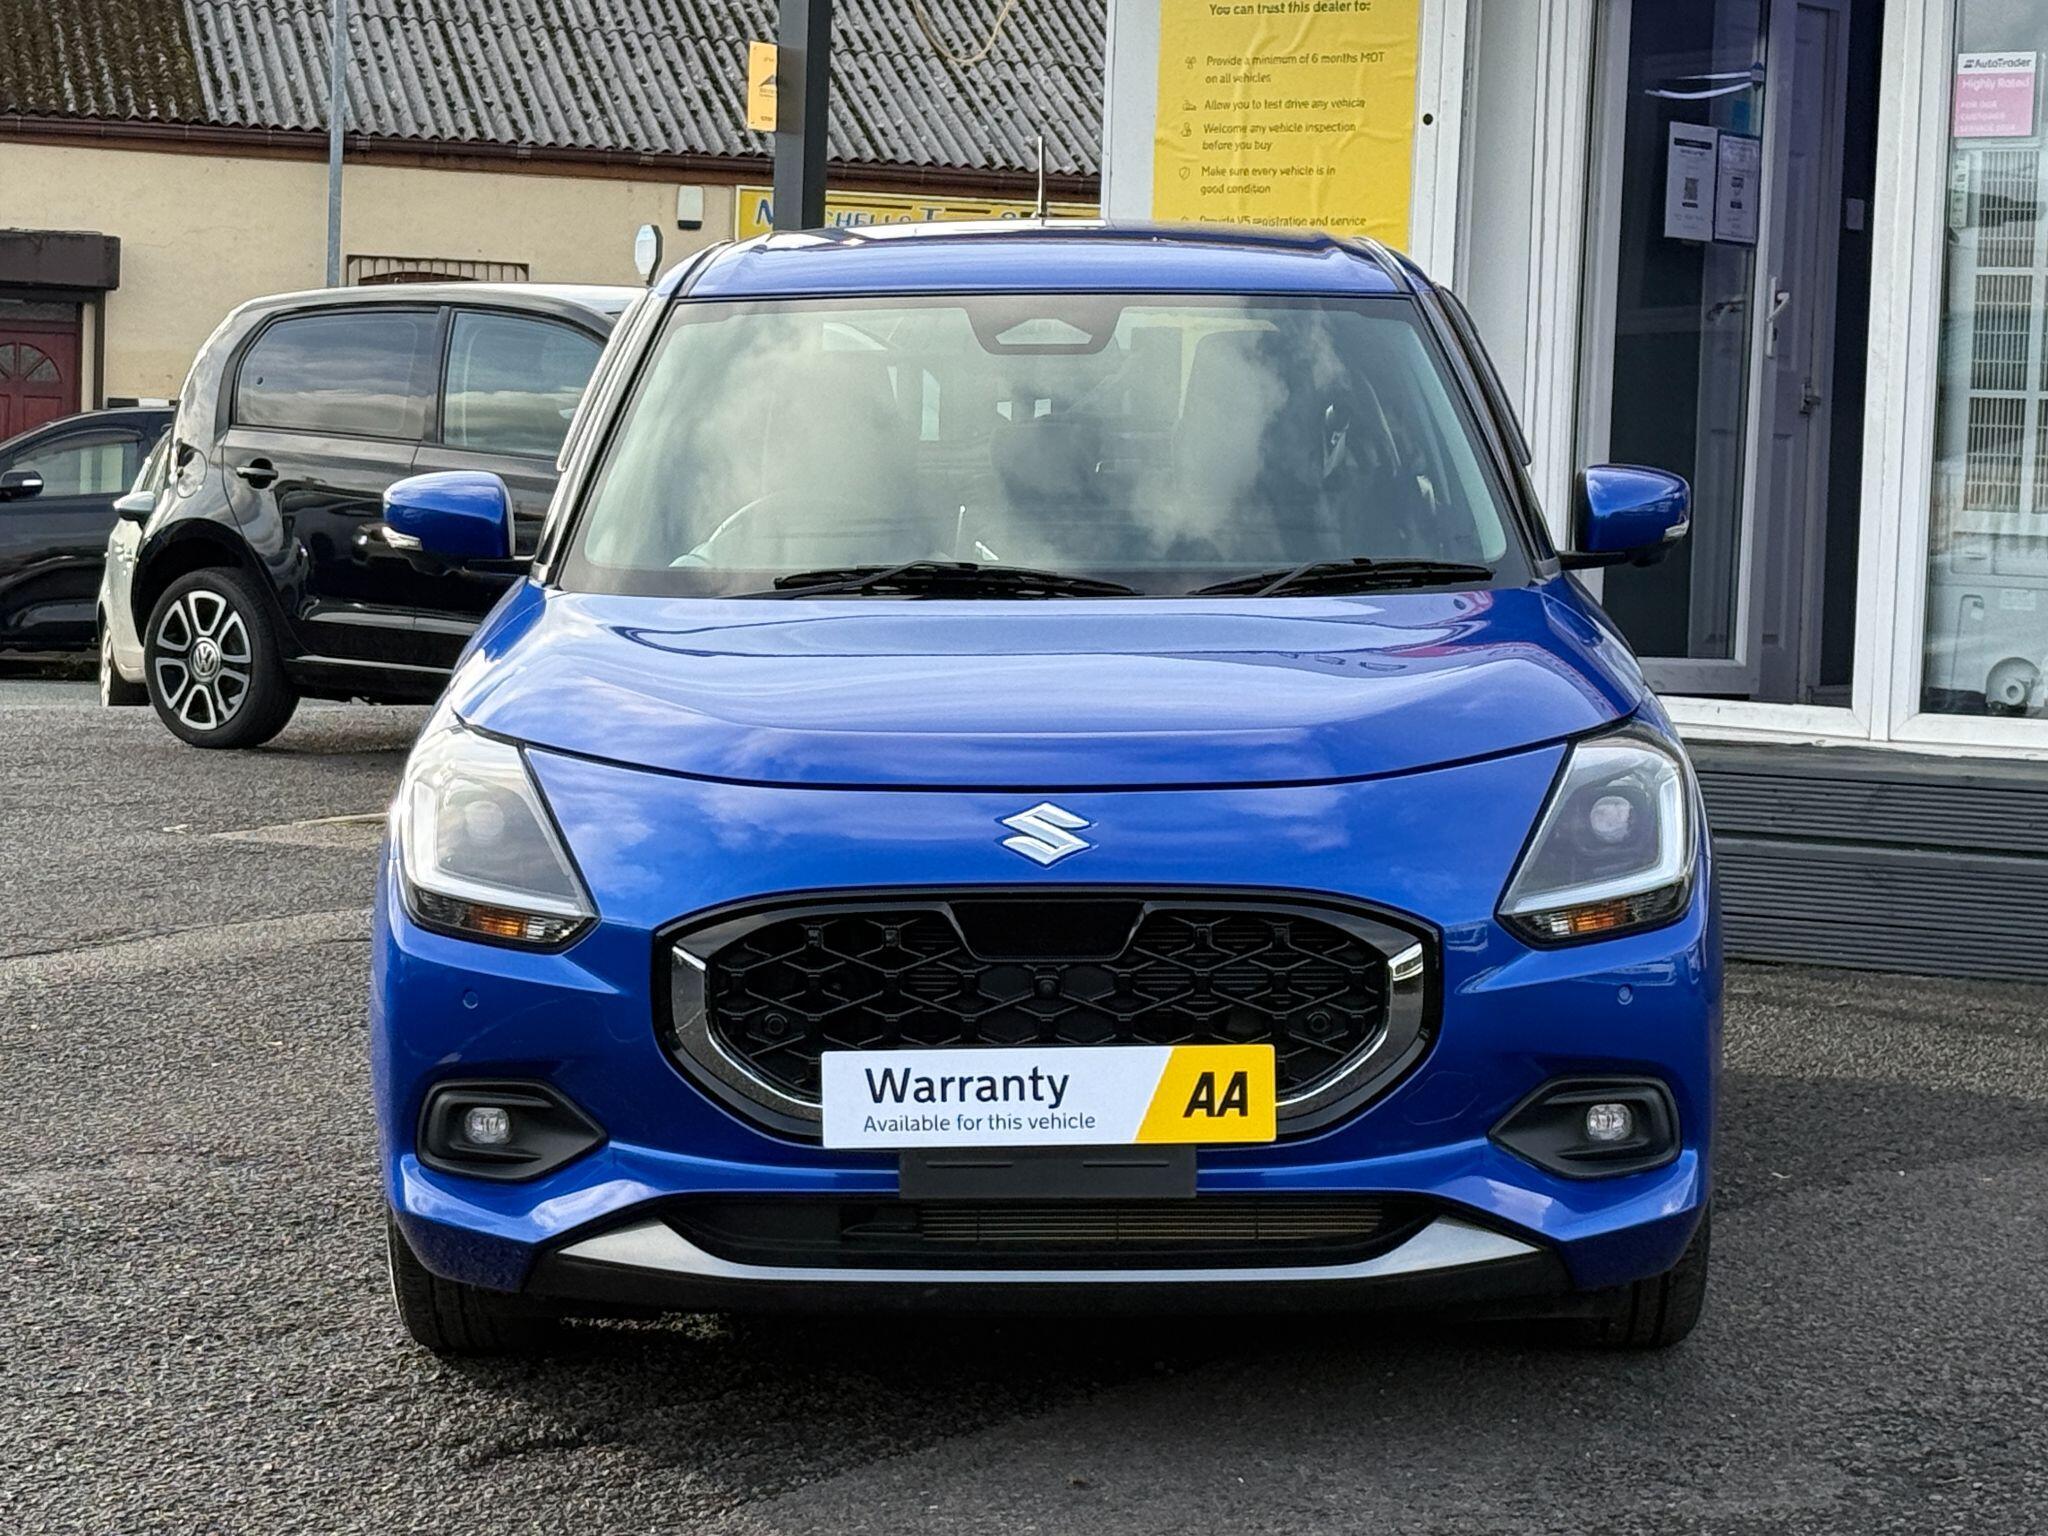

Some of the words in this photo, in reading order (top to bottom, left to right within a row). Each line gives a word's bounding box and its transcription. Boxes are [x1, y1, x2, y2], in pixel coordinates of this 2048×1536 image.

[1209, 3, 1231, 15] You
[1233, 5, 1255, 15] can
[1257, 3, 1285, 14] trust
[1287, 1, 1311, 13] this
[1313, 0, 1352, 12] dealer
[1353, 0, 1372, 12] to:
[1206, 55, 1243, 66] Provide
[1252, 55, 1298, 65] minimum
[1299, 53, 1310, 64] of
[1311, 53, 1319, 63] 6
[1320, 53, 1359, 63] months
[1360, 51, 1385, 63] MOT
[1974, 57, 2032, 69] AutoTrader
[1205, 75, 1218, 84] on
[1219, 73, 1231, 83] all
[1232, 72, 1272, 83] vehicles
[1962, 78, 1996, 91] Highly
[1997, 76, 2030, 89] Rated
[1204, 99, 1231, 110] Allow
[1232, 101, 1250, 112] you
[1251, 99, 1262, 109] to
[1264, 99, 1283, 109] test
[1284, 99, 1310, 109] drive
[1311, 100, 1329, 111] any
[1330, 98, 1366, 109] vehicle
[1203, 122, 1248, 133] Welcome
[1249, 124, 1267, 135] any
[1268, 122, 1303, 133] vehicle
[1304, 122, 1357, 134] inspection
[1202, 140, 1233, 150] before
[1234, 141, 1252, 152] you
[1254, 140, 1273, 152] buy
[1201, 166, 1228, 177] Make
[1229, 167, 1250, 176] sure
[1251, 167, 1278, 178] every
[1279, 166, 1314, 176] vehicle
[1316, 165, 1325, 176] is
[1326, 165, 1336, 176] in
[1200, 183, 1225, 195] good
[1226, 183, 1271, 194] condition
[1309, 215, 1329, 226] and
[1330, 215, 1367, 226] service
[865, 1066, 1070, 1108] Warranty
[1183, 1071, 1249, 1118] AA
[863, 1114, 951, 1133] Available
[956, 1114, 983, 1131] for
[988, 1113, 1023, 1131] this
[1027, 1112, 1096, 1130] vehicle
